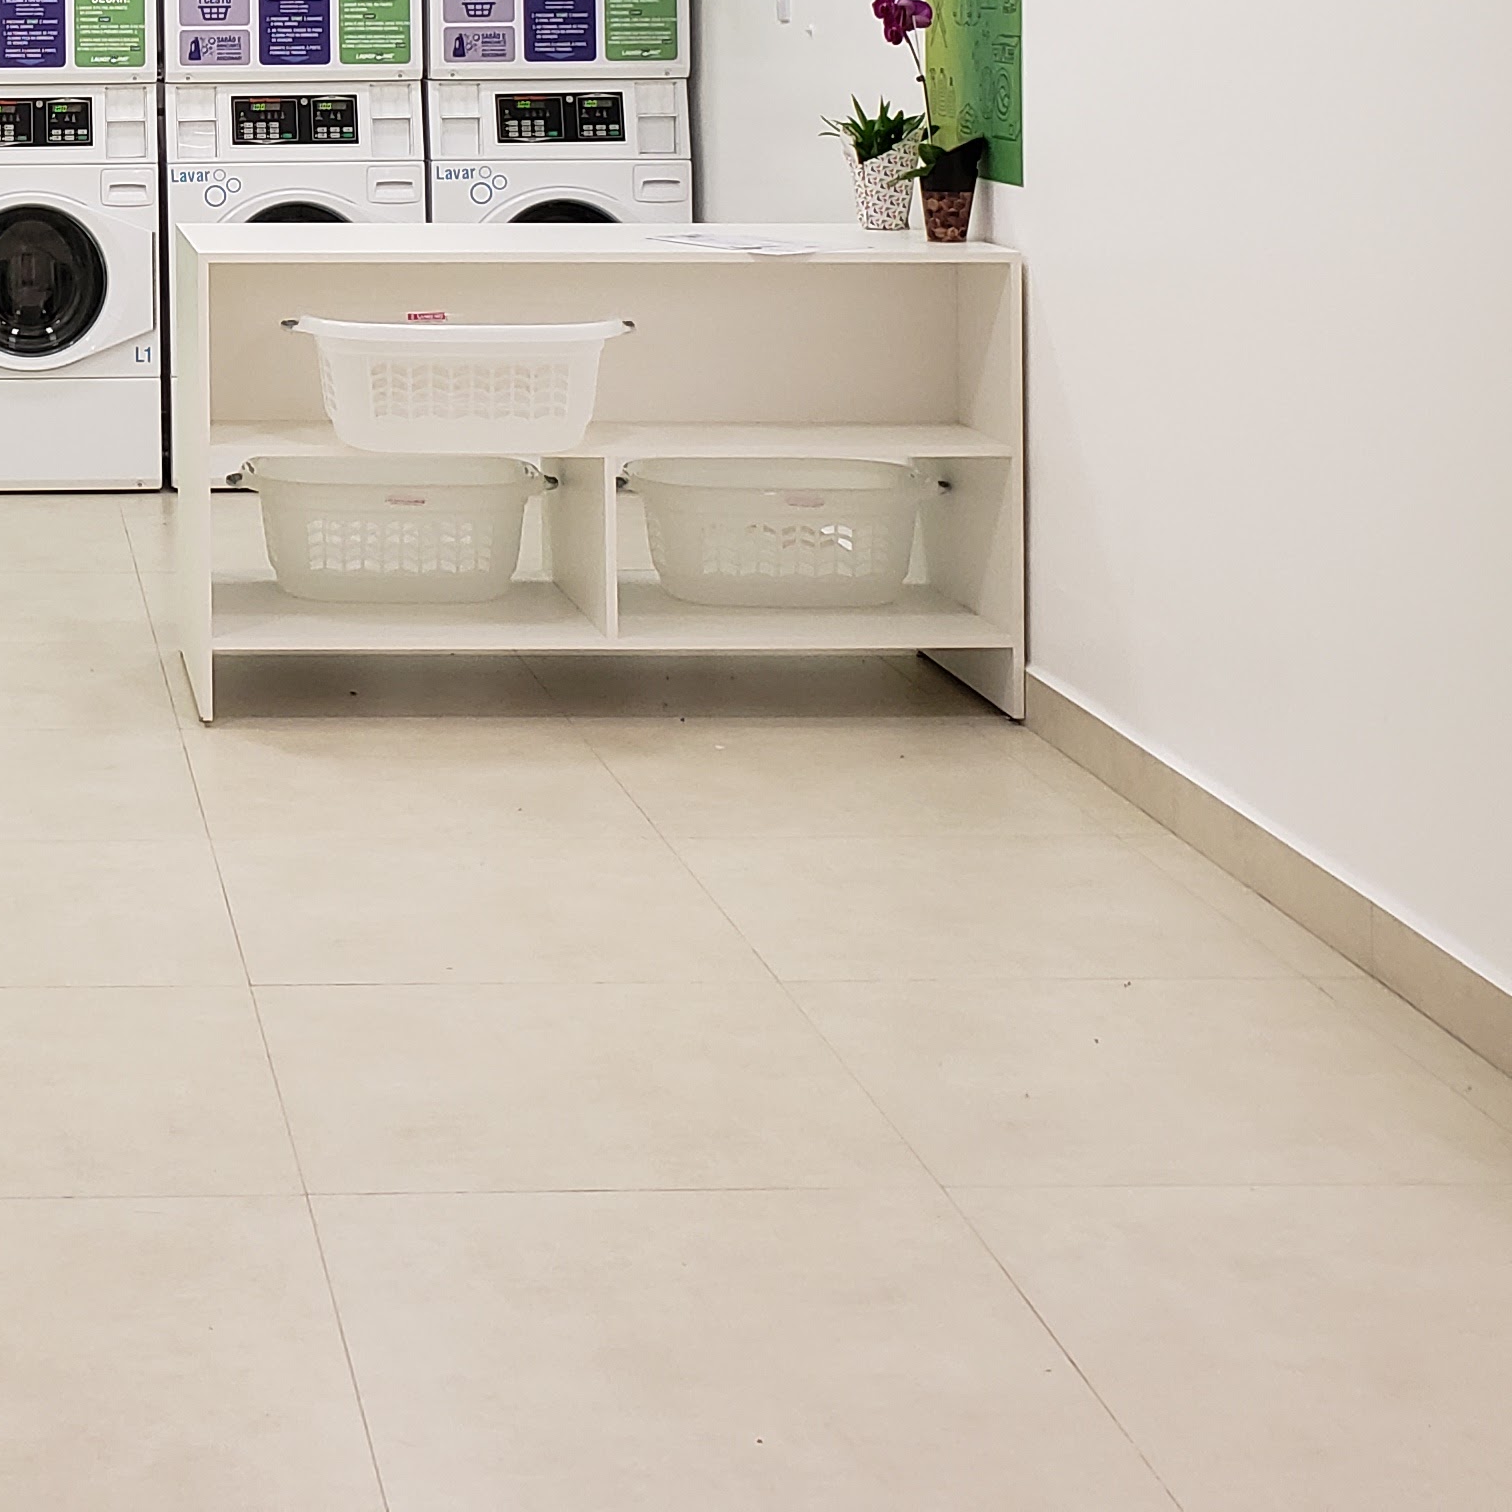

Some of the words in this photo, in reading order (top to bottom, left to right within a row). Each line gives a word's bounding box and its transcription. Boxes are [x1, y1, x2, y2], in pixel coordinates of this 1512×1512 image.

[171, 168, 210, 183] Lavar
[435, 165, 476, 181] Lavar
[135, 346, 152, 364] L1
